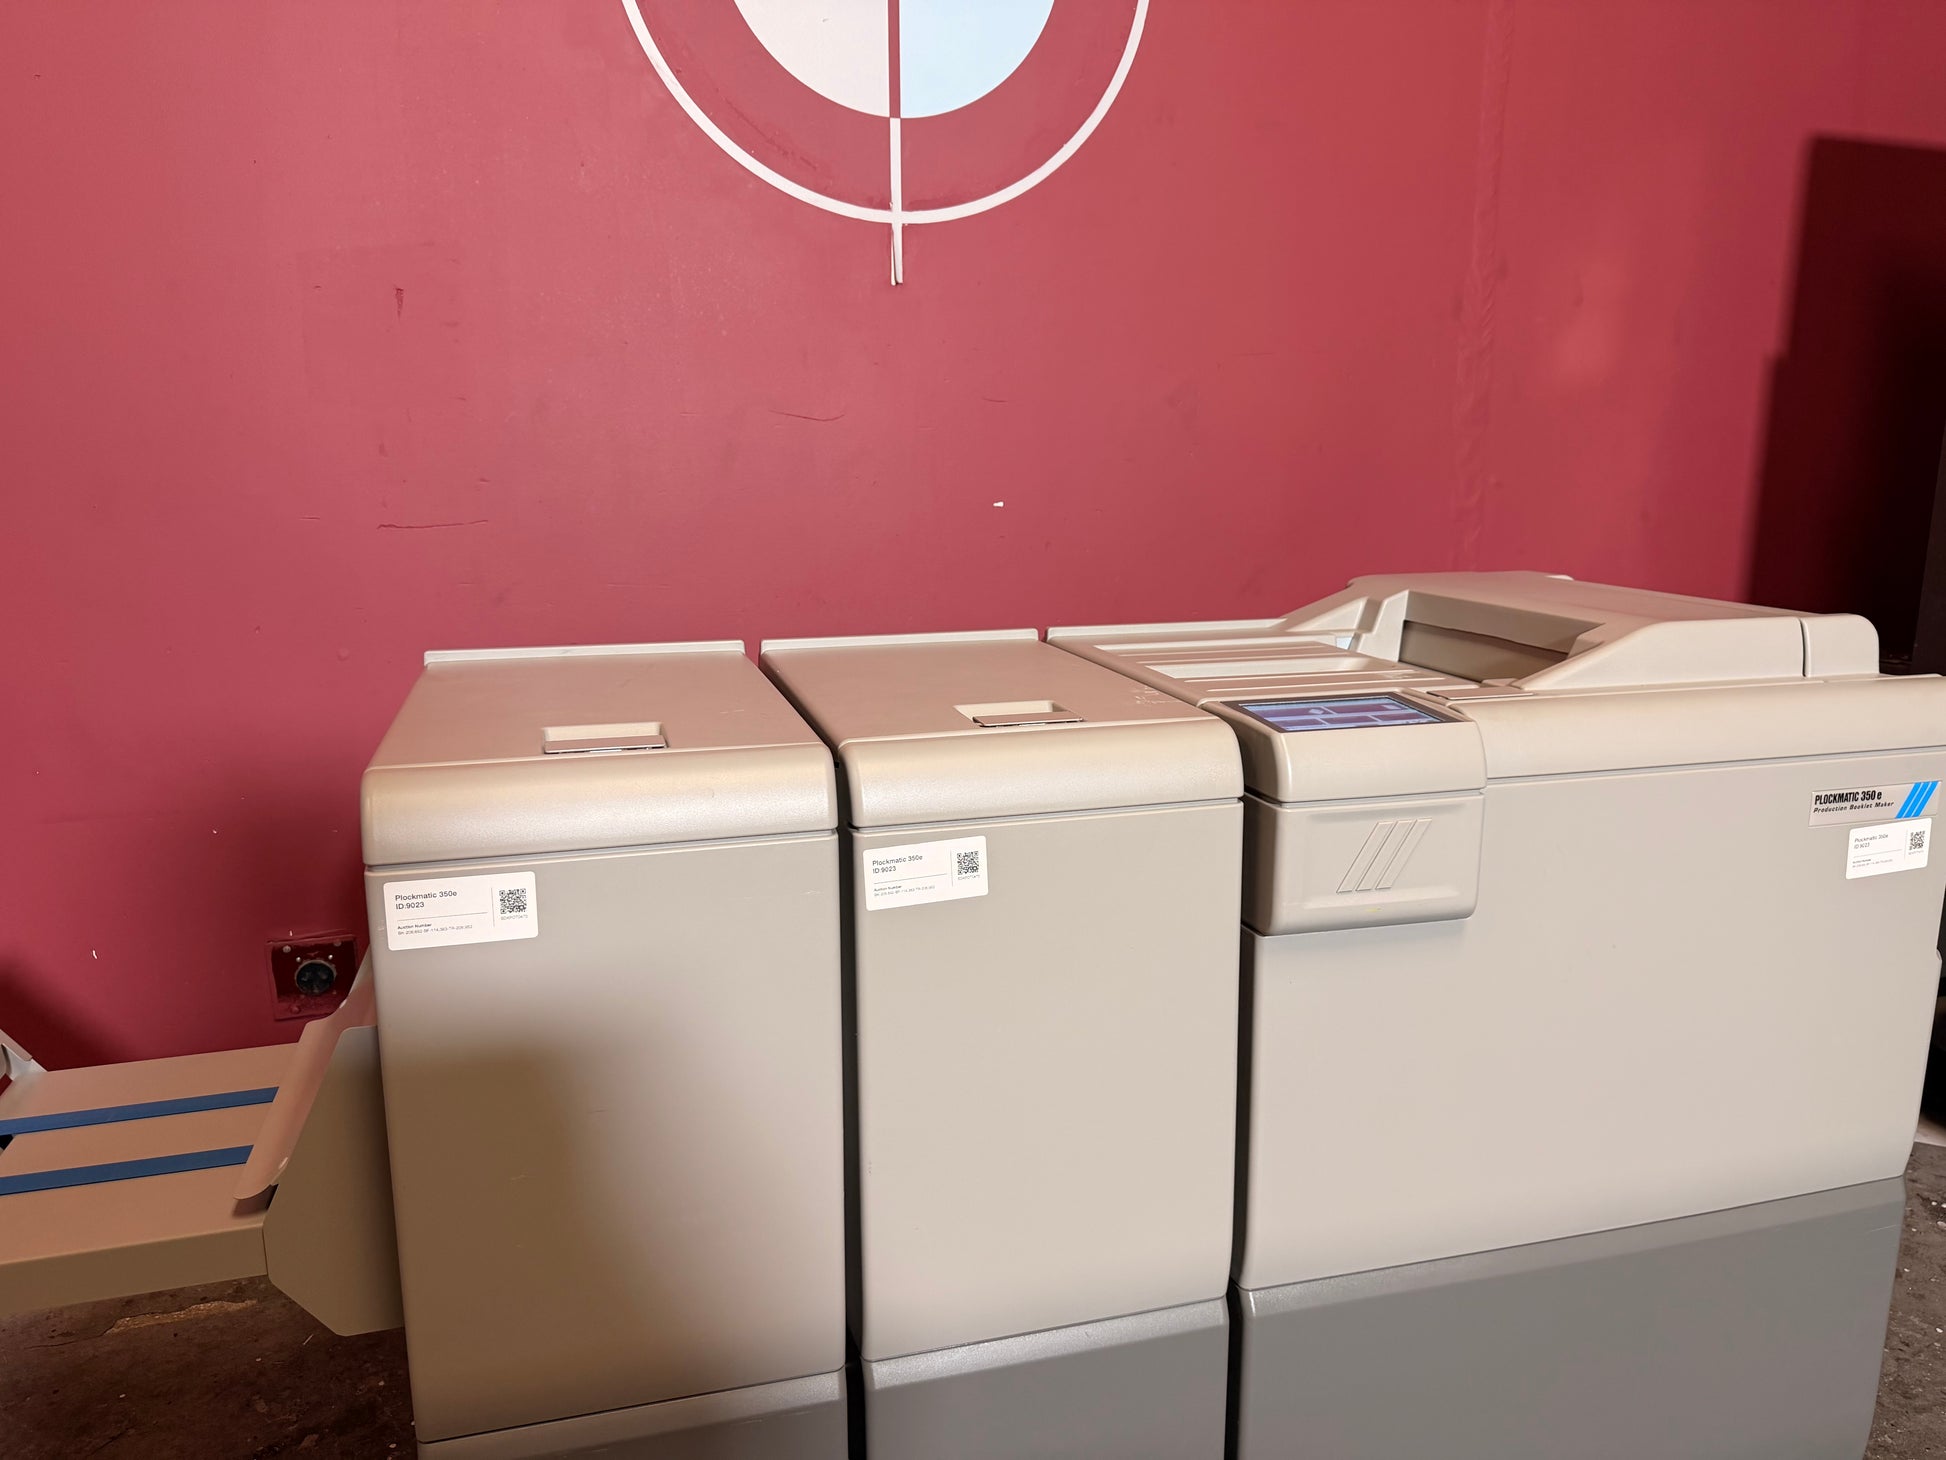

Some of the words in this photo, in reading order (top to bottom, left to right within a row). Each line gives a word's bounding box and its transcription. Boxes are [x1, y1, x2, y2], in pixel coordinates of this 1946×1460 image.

[1815, 791, 1859, 805] PLOCKMATIC
[1860, 790, 1876, 801] 350
[1877, 791, 1882, 800] e
[872, 857, 907, 866] Plockmatic
[395, 892, 437, 901] Plockmatic
[439, 890, 457, 898] 350e
